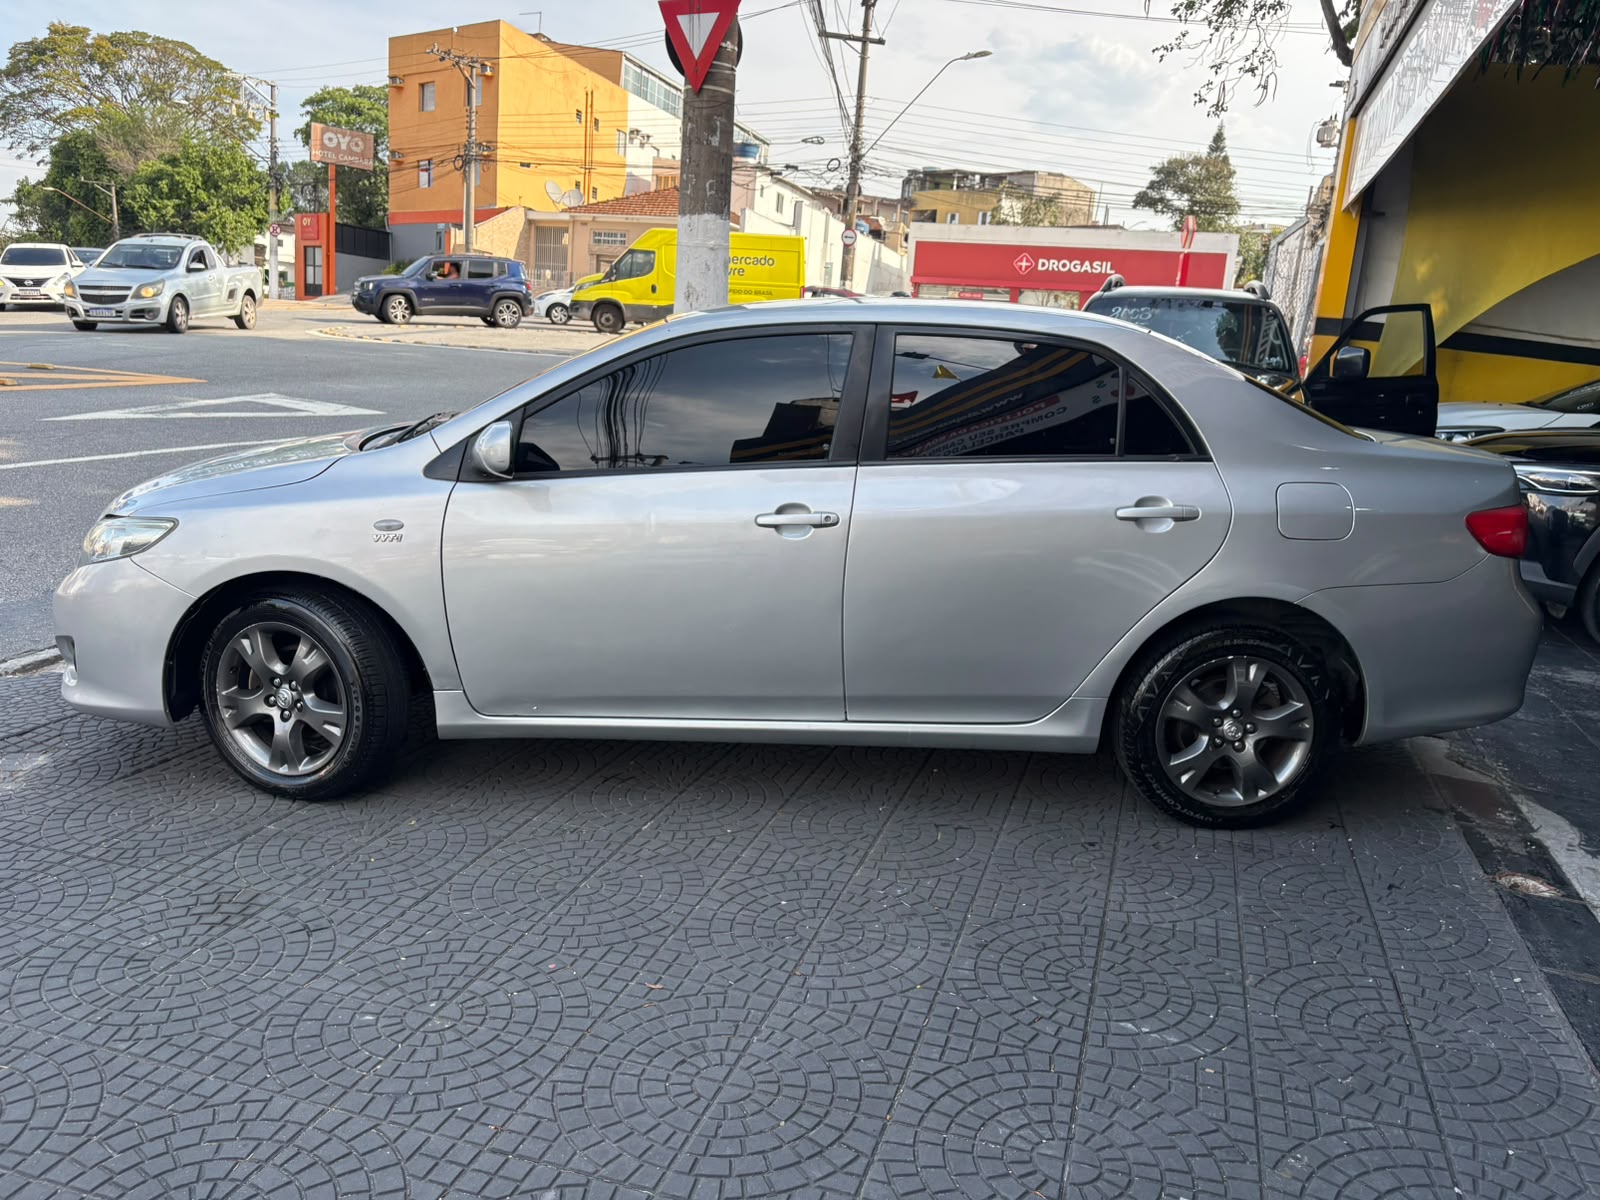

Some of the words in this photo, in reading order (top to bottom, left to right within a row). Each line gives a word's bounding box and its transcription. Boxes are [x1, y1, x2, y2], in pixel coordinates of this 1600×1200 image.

[323, 132, 364, 152] OYO
[312, 149, 337, 160] HOTEL
[728, 267, 745, 276] vre
[1037, 258, 1116, 274] DROGASIL
